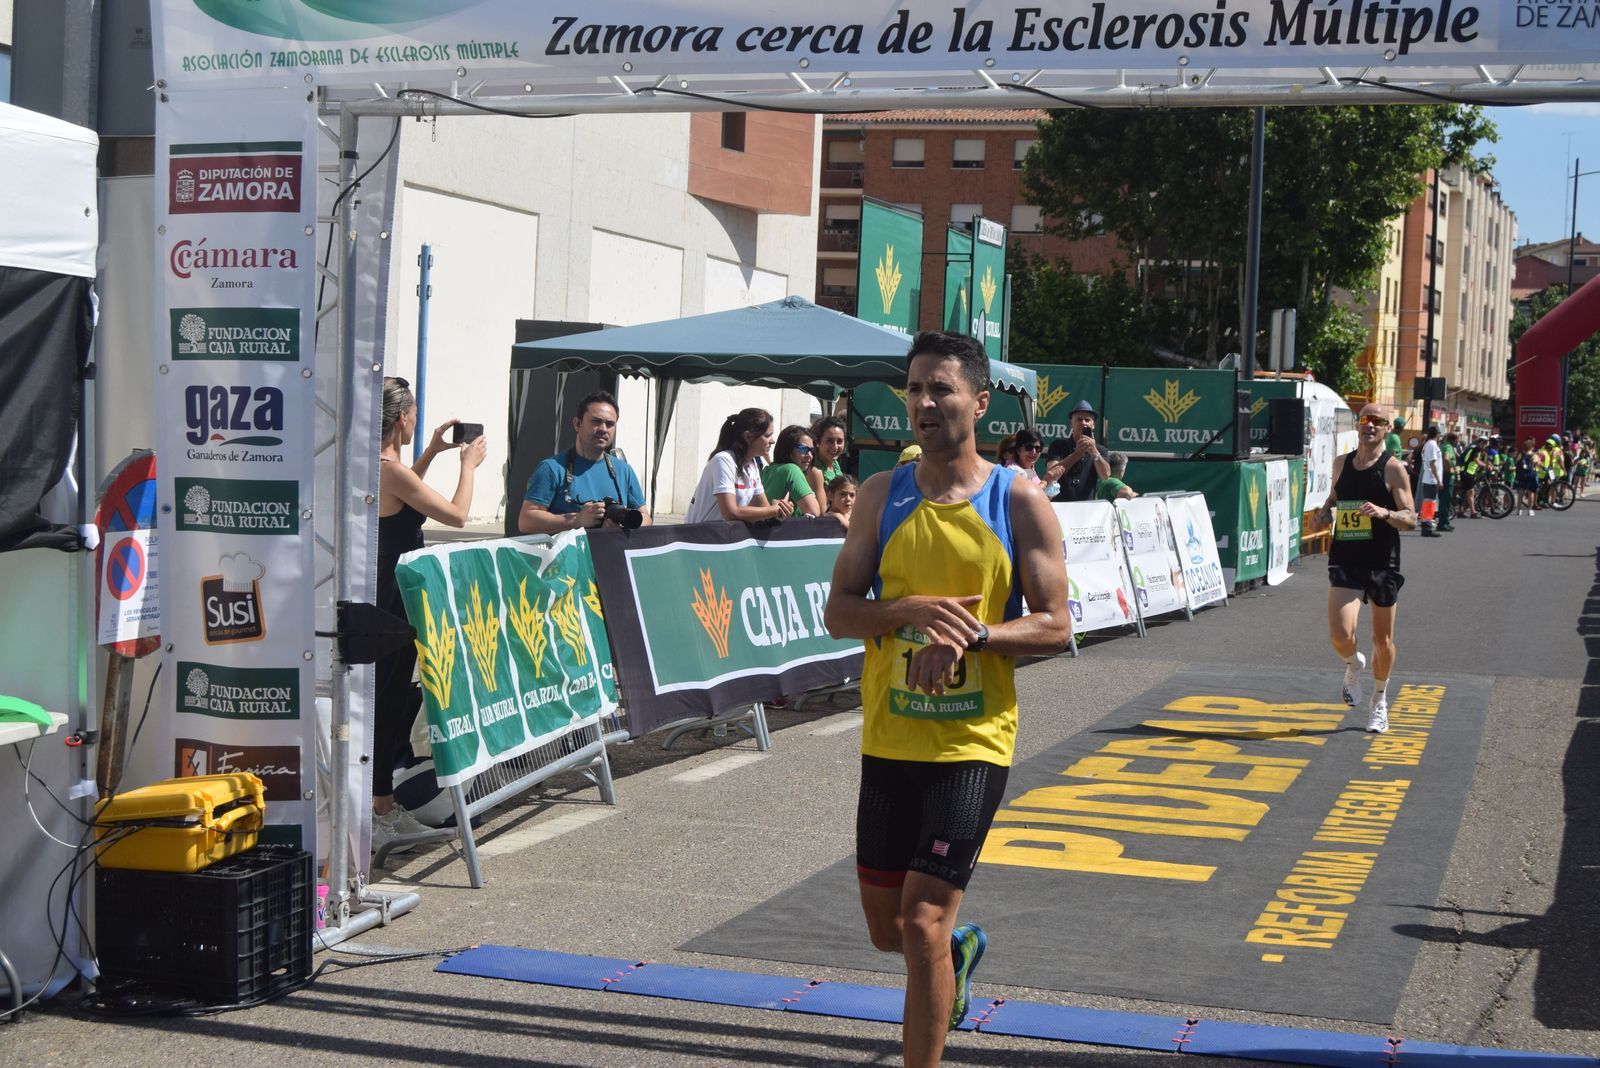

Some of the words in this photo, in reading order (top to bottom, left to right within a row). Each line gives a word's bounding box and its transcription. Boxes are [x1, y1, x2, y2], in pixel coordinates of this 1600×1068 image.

[1516, 5, 1549, 28] DE
[544, 15, 724, 56] Zamora
[735, 23, 864, 55] cerca
[877, 9, 934, 55] de
[947, 7, 995, 54] la
[1006, 1, 1249, 53] Esclerosis
[1262, 0, 1480, 56] Múltiple
[182, 50, 263, 73] ASOCIACIÓN
[269, 48, 344, 68] ZAMORANA
[350, 47, 369, 65] DE
[375, 44, 450, 64] ESCLEROSIS
[456, 39, 520, 61] MÚLTIPLE
[199, 164, 272, 181] DIPUTACIÓN
[275, 167, 294, 179] DE
[197, 181, 295, 202] ZAMORA
[210, 277, 254, 289] Zamora
[207, 327, 292, 342] FUNDACION
[208, 341, 237, 355] CAJA
[239, 342, 291, 355] RURAL
[184, 385, 284, 446] gaza
[863, 415, 902, 431] CAJA
[1034, 420, 1074, 439] RURA
[1118, 427, 1160, 443] CAJA
[1164, 428, 1224, 445] RURAL
[186, 448, 227, 462] Ganaderos
[228, 450, 240, 462] de
[241, 450, 284, 463] Zamora
[211, 500, 291, 516] FUNDACION
[211, 514, 236, 528] CAJA
[238, 516, 290, 529] RURAL
[1341, 511, 1361, 528] 49
[206, 593, 256, 628] Susi
[740, 585, 810, 648] CAJA
[902, 647, 967, 690] 19
[210, 684, 291, 700] FUNDACION
[210, 697, 236, 713] CAJA
[239, 701, 291, 714] RURAL
[910, 700, 937, 712] CAJA
[939, 700, 978, 713] RURAL
[977, 695, 1353, 882] PIDEPAR
[1245, 851, 1378, 949] REFORMA
[1312, 779, 1412, 846] INTEGRAL
